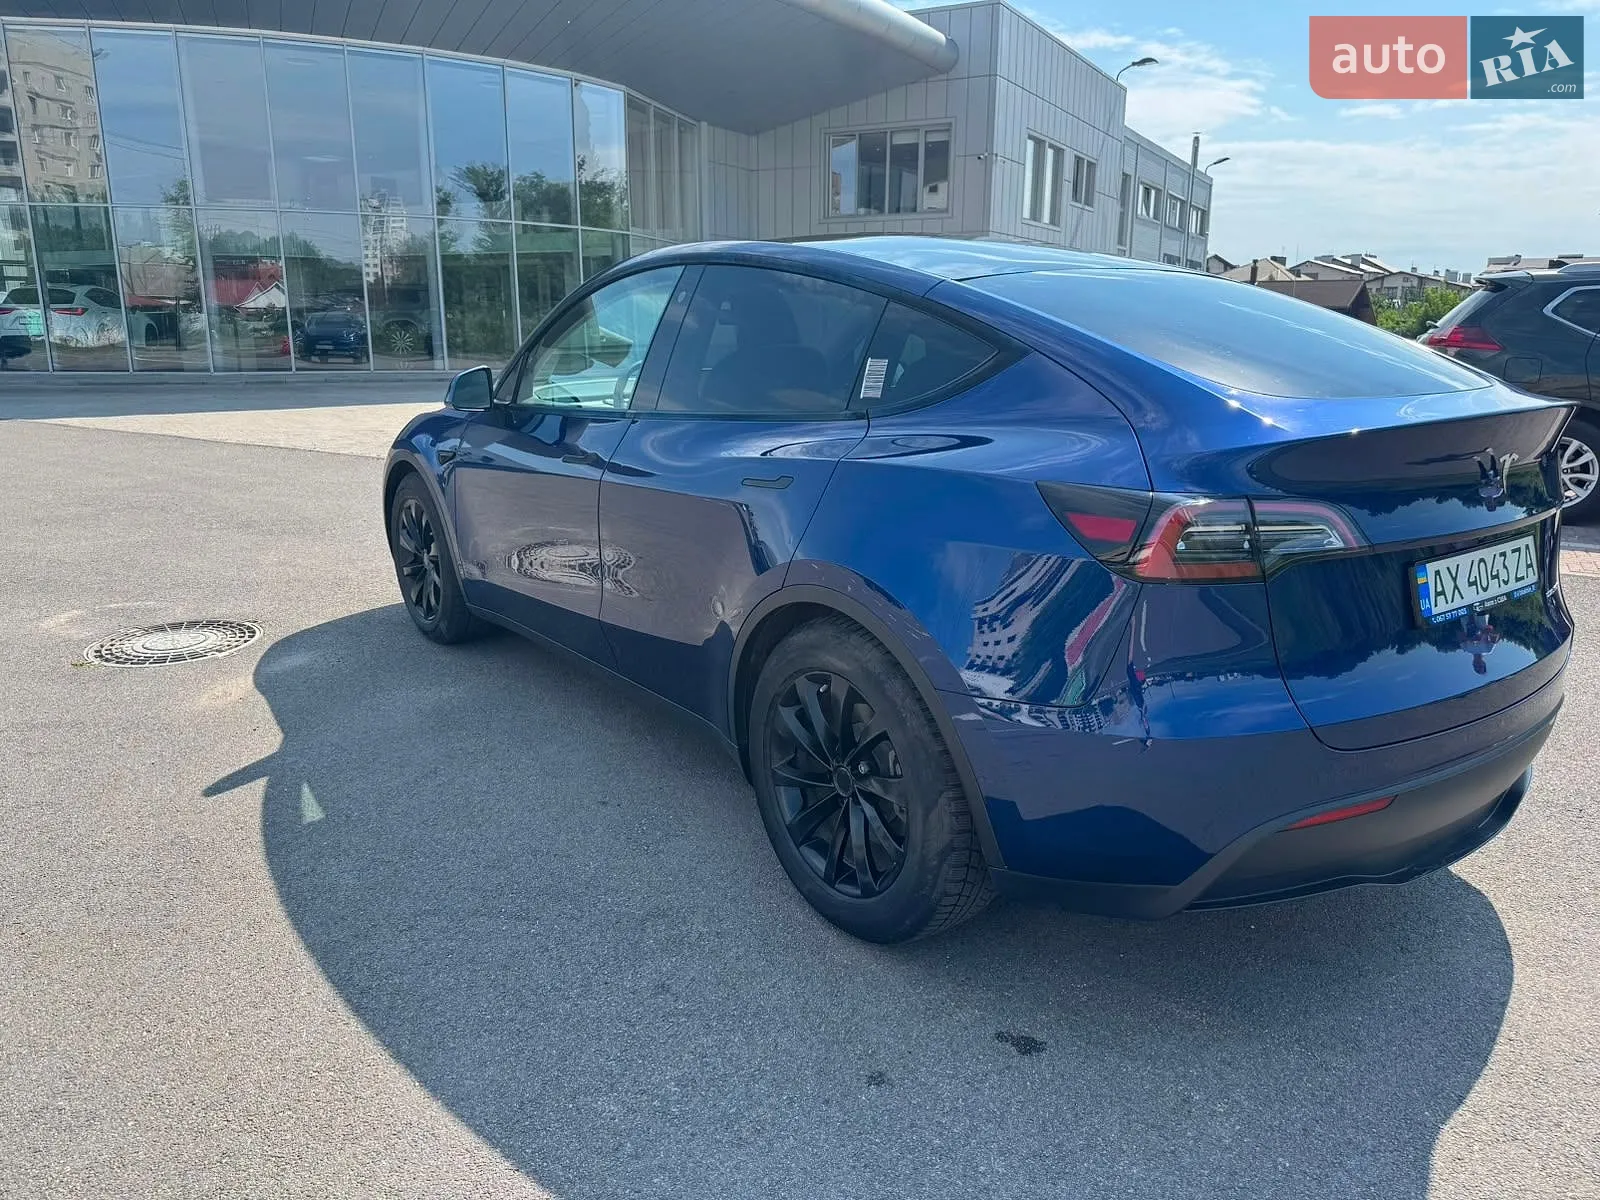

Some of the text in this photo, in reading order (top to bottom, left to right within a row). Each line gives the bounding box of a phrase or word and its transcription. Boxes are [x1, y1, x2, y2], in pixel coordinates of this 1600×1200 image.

[1434, 543, 1536, 608] AX 4043 ZA
[1420, 598, 1431, 610] UA
